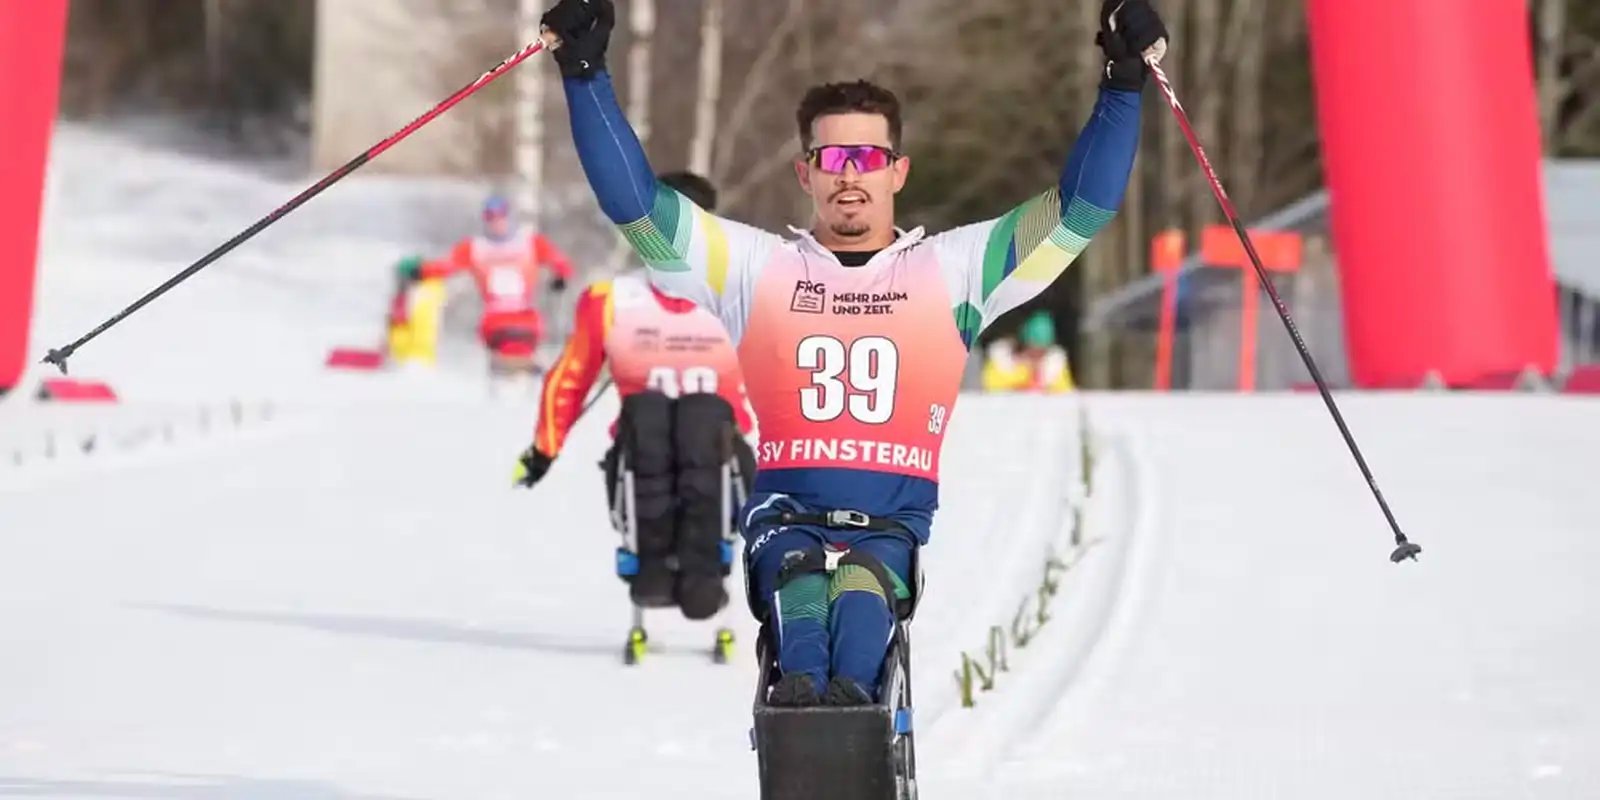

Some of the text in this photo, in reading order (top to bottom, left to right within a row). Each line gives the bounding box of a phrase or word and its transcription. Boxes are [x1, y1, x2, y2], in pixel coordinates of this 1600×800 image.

[832, 304, 893, 315] UND ZEIT.
[833, 291, 908, 303] MEHR RAUM
[796, 335, 899, 424] 39
[928, 403, 946, 434] 39
[790, 438, 932, 471] FINSTERAU
